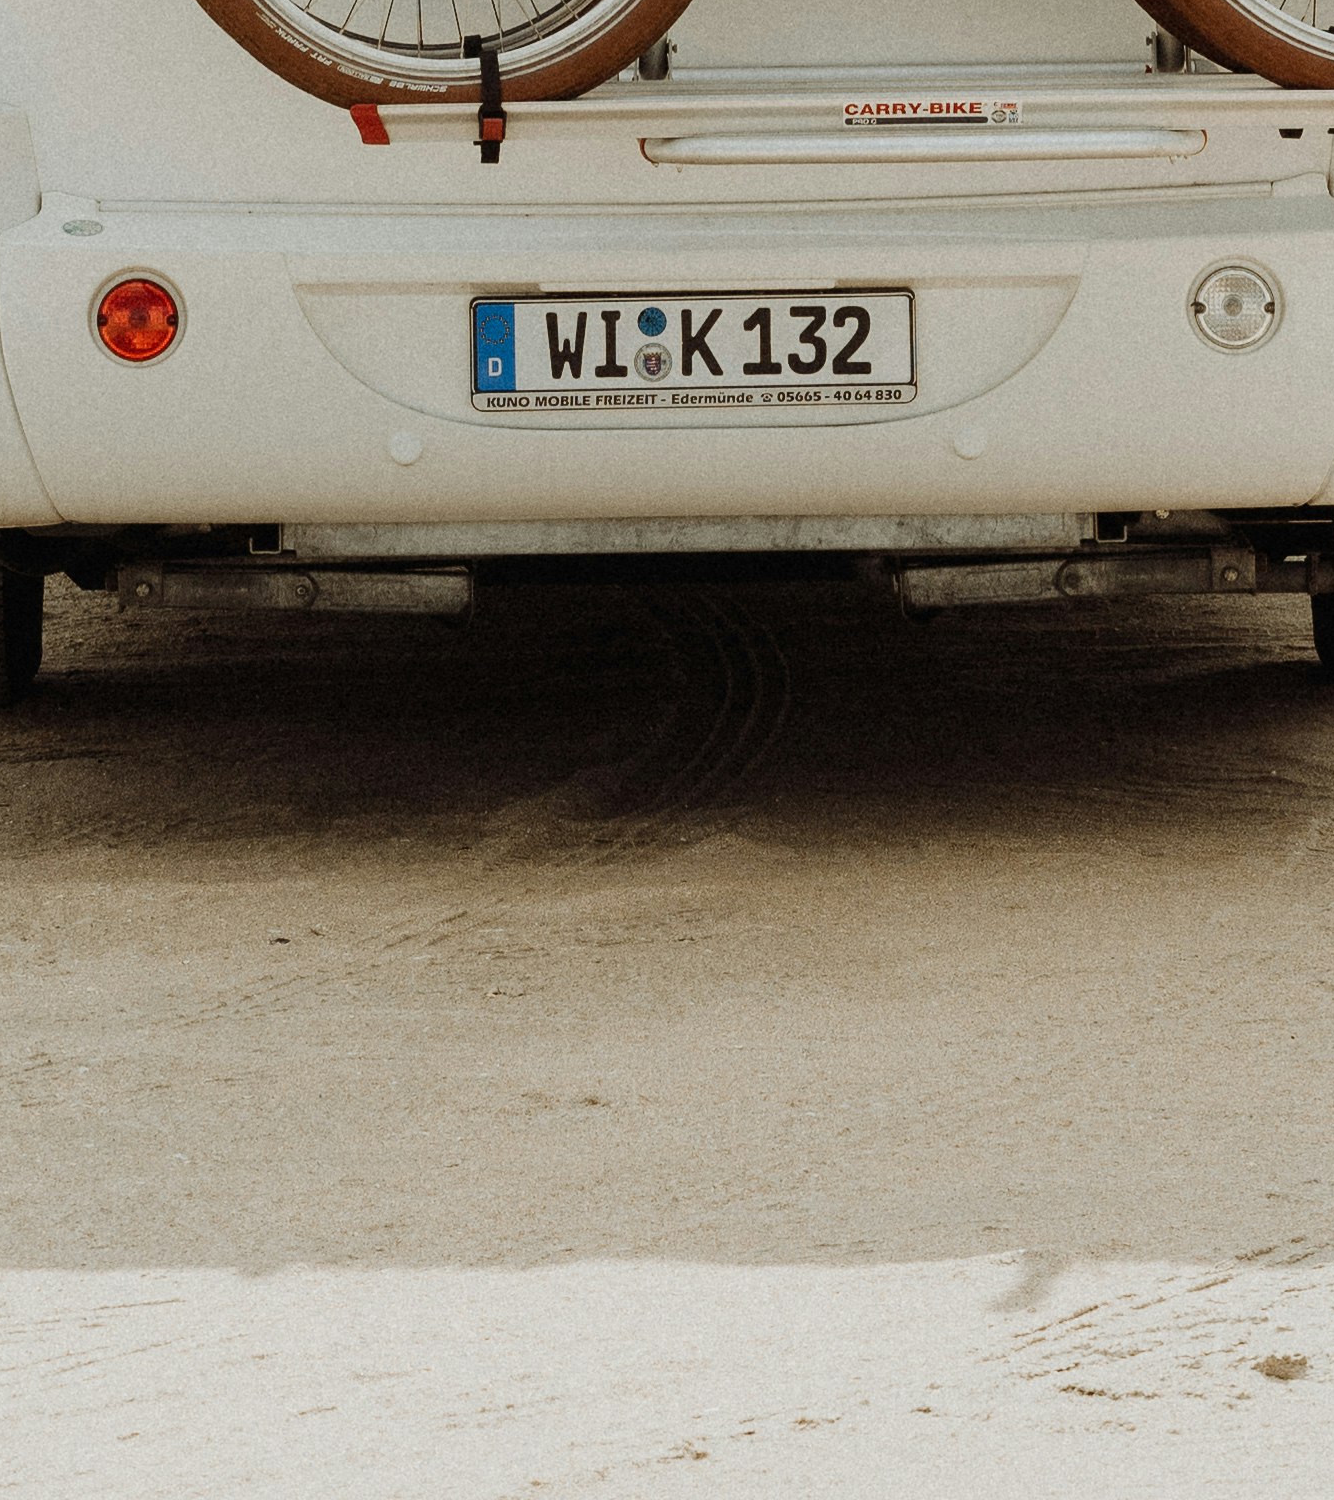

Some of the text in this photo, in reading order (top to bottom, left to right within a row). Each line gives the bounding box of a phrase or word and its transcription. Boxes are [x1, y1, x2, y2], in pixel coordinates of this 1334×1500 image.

[844, 102, 983, 116] CARRY-BIKE
[545, 309, 628, 380] WI
[680, 308, 724, 377] K
[742, 305, 872, 376] 132
[488, 357, 502, 377] D
[486, 396, 530, 408] KUNO
[535, 394, 591, 407] MOBILE
[595, 393, 658, 406] FREIZEIT
[671, 391, 753, 404] Edermünde
[777, 391, 822, 403] 05665
[833, 390, 852, 402] 40
[854, 389, 873, 401] 64
[875, 389, 902, 401] 830
